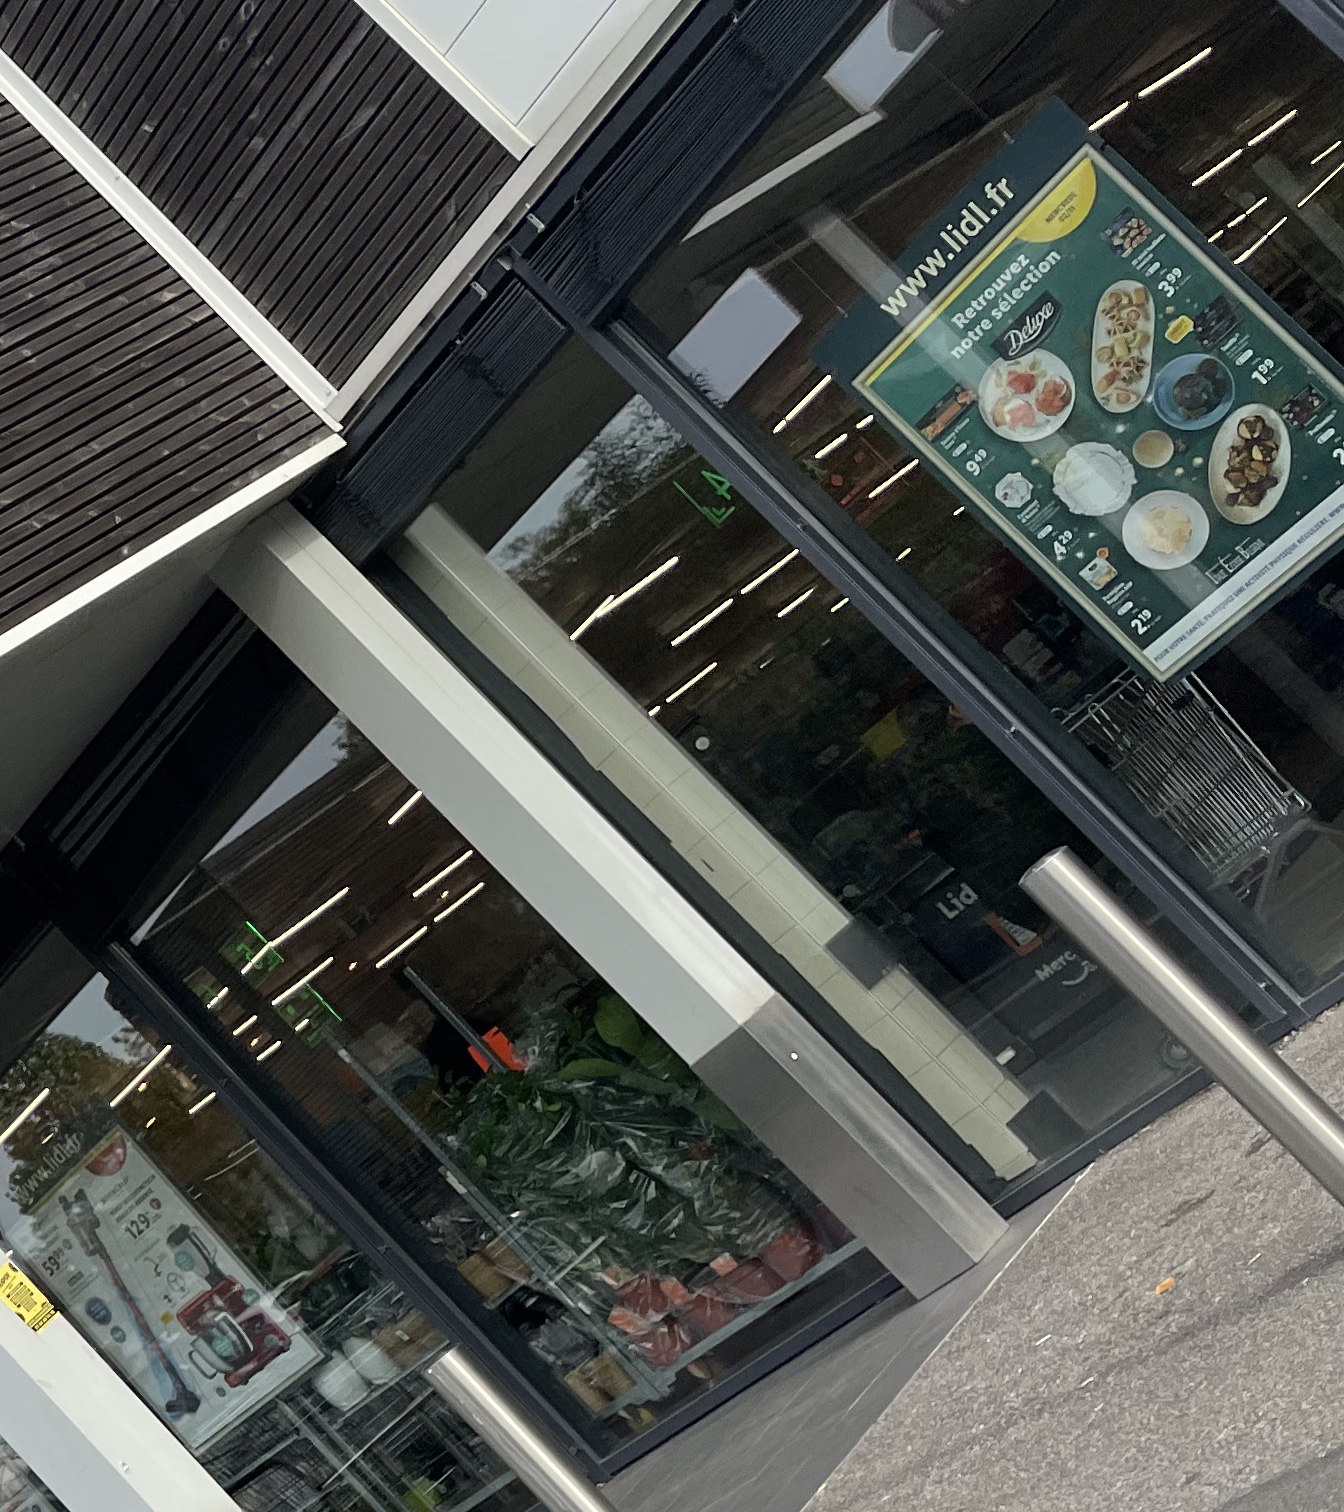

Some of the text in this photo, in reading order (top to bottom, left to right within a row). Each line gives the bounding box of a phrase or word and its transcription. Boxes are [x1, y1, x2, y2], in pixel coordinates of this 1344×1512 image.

[879, 175, 1017, 317] www.lidl.fr
[951, 253, 1031, 330] Retrouvez
[950, 315, 995, 360] notre
[986, 248, 1062, 322] sélection
[999, 298, 1057, 357] Deluxe
